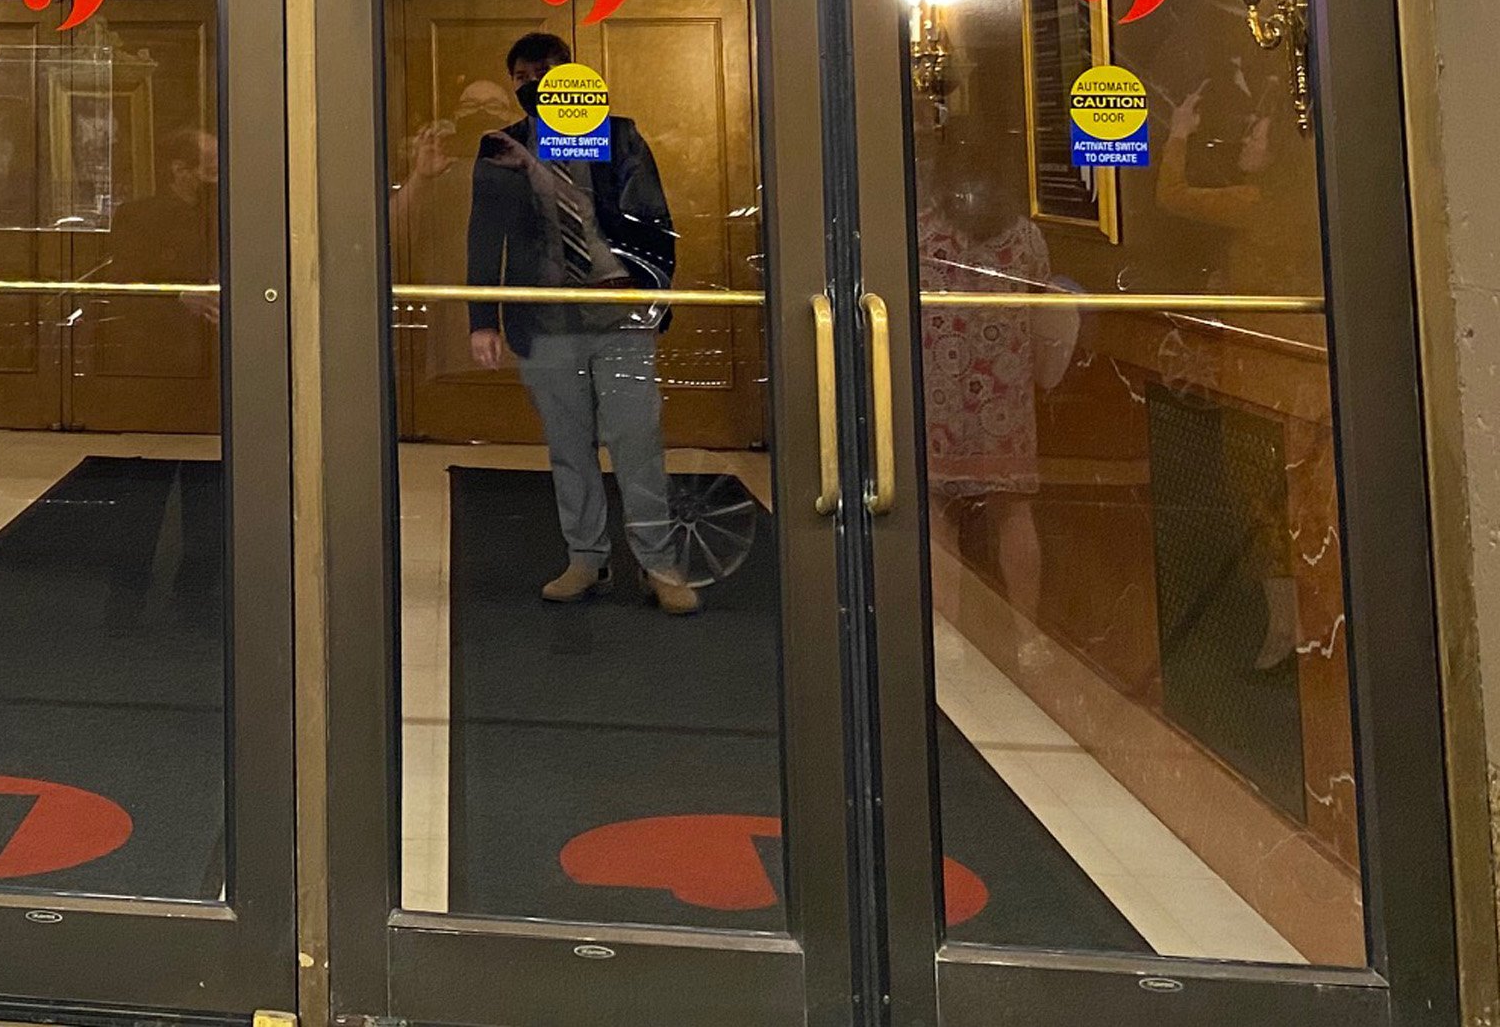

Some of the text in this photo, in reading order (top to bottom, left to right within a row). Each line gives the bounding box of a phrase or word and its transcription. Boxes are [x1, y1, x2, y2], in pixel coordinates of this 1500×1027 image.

[543, 79, 602, 89] AUTOMATIC
[1077, 82, 1140, 92] AUTOMATIC
[539, 93, 607, 104] CAUTION
[1072, 96, 1145, 108] CAUTION
[558, 108, 588, 119] DOOR
[1093, 113, 1125, 123] DOOR
[540, 137, 609, 146] ACTIVATE SWITCH
[1074, 141, 1148, 151] ACTIVATE SWITCH
[550, 147, 599, 158] TO OPERATE
[1085, 153, 1138, 163] TO OPERATE
